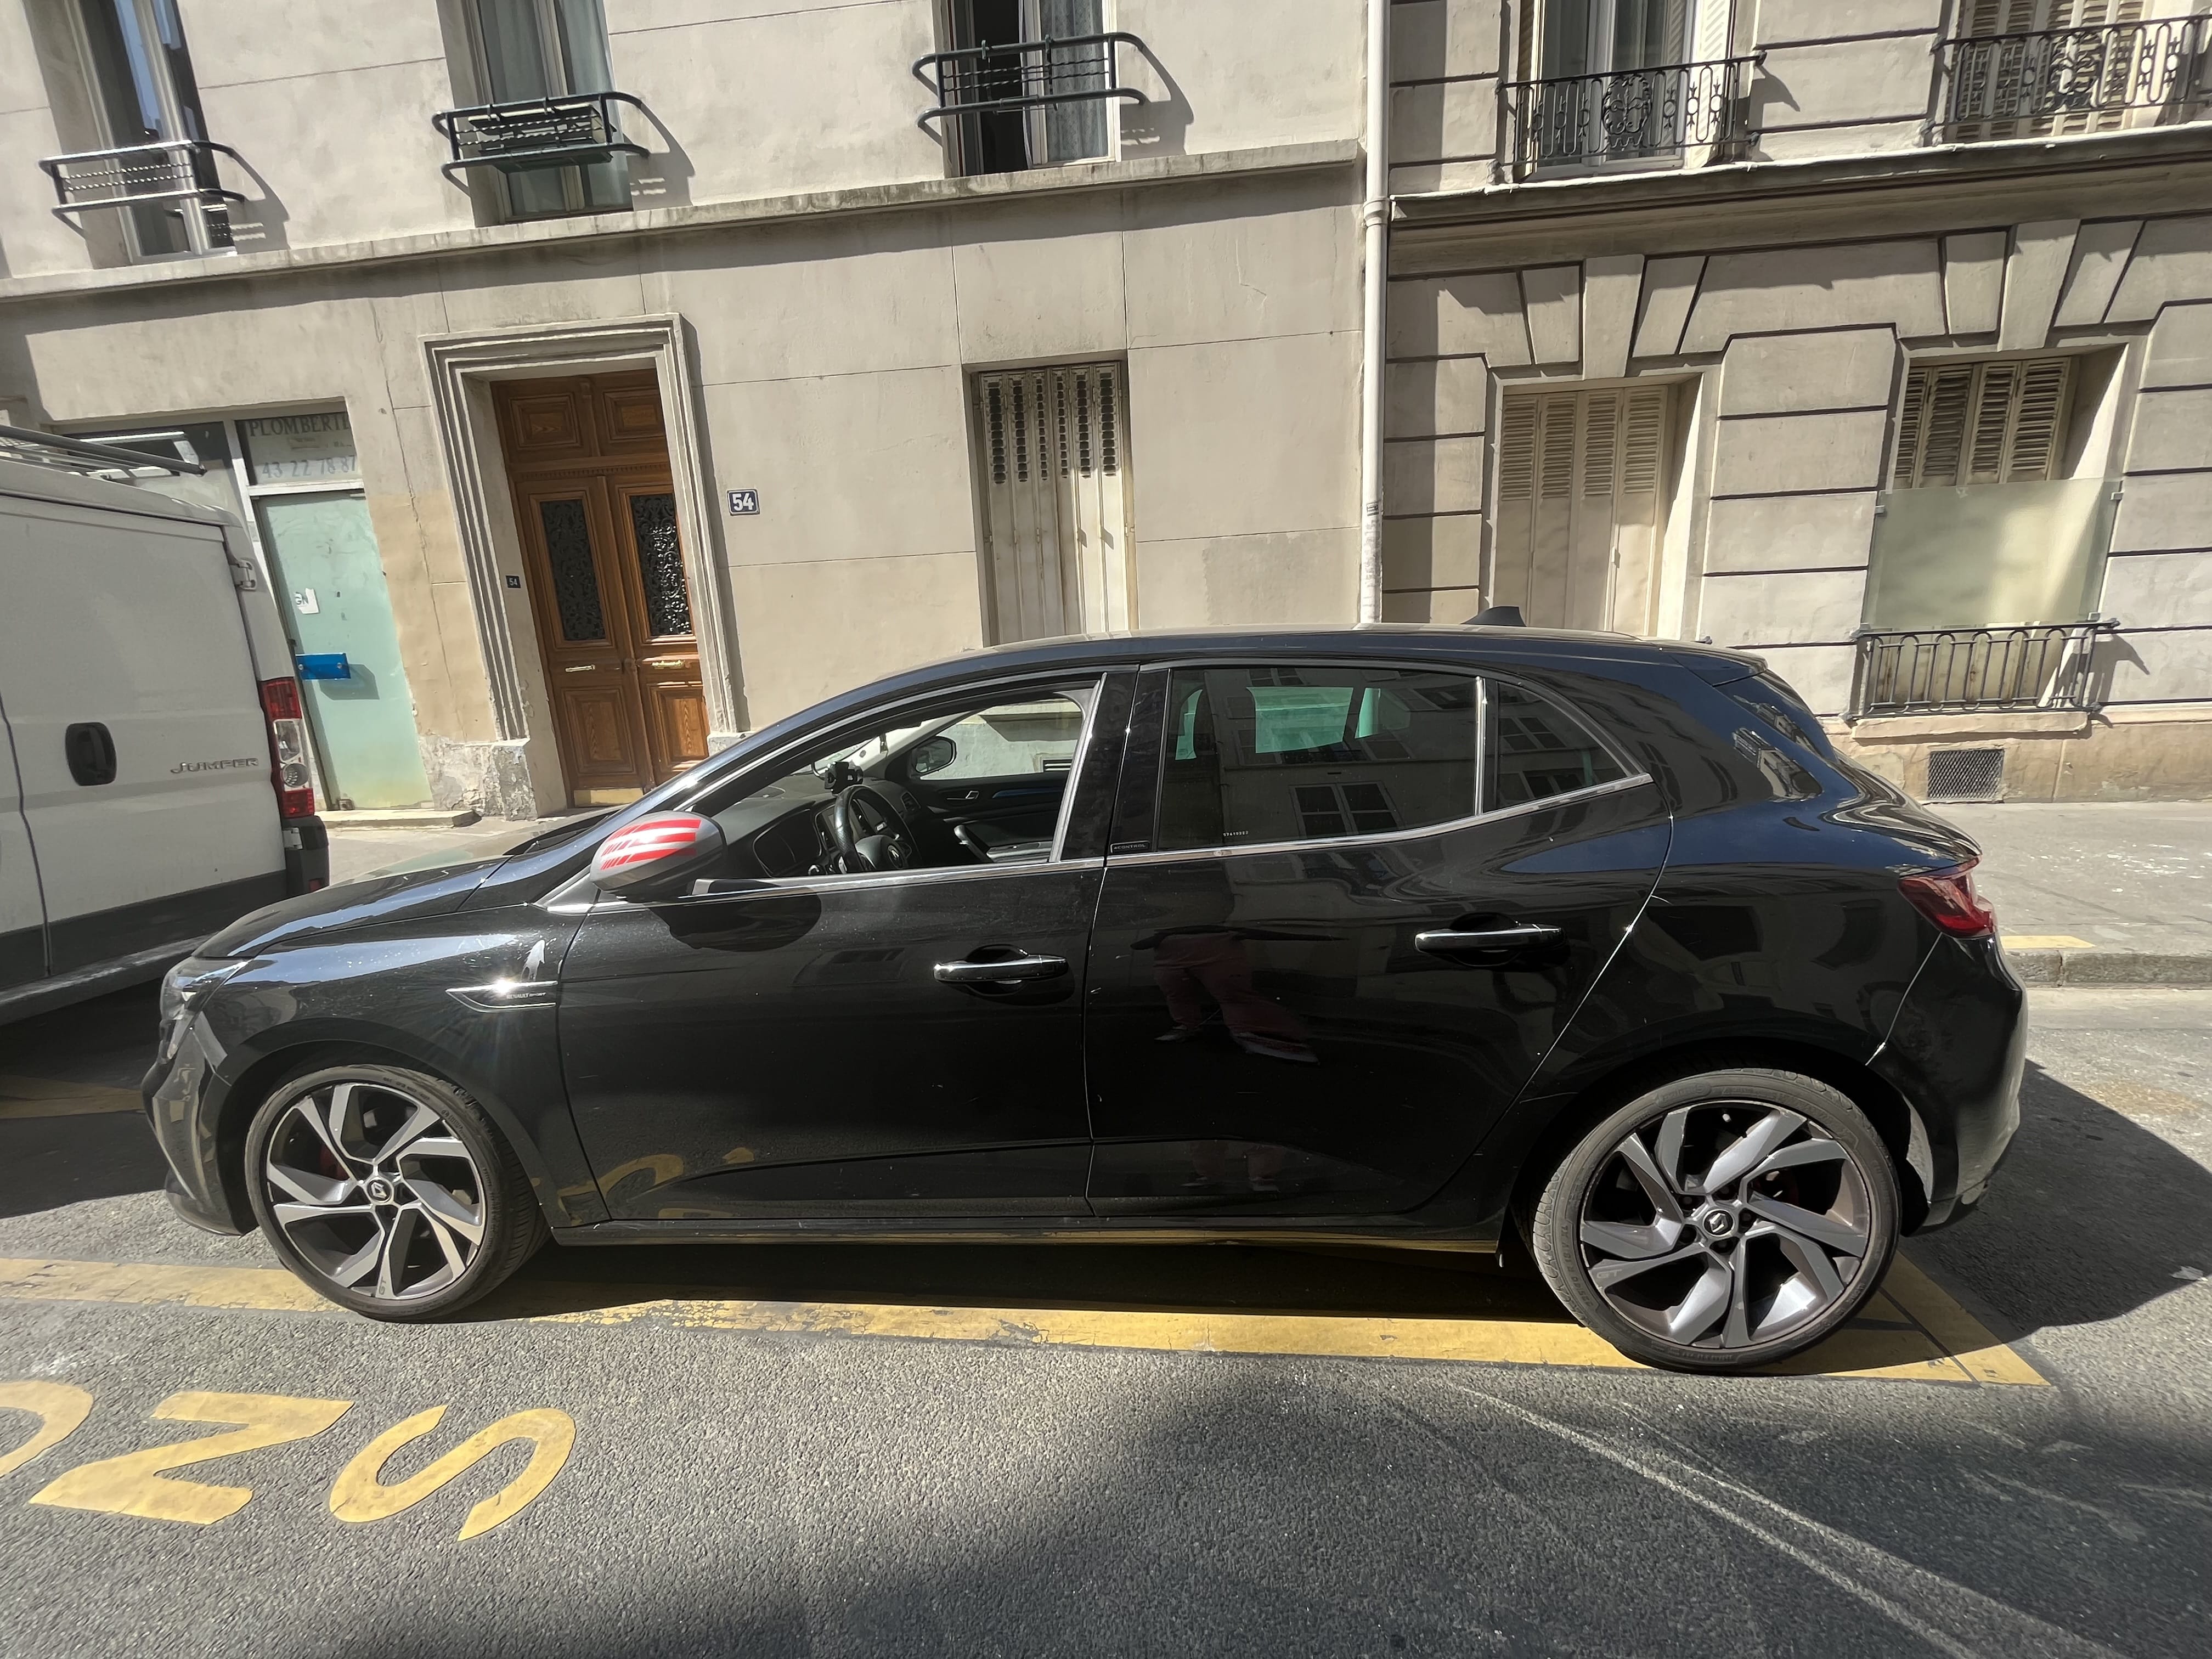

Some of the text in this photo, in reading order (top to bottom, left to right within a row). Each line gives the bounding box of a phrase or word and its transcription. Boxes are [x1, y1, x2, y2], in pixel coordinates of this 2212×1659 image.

[262, 462, 283, 478] 43
[290, 460, 312, 477] 22
[341, 454, 356, 472] 87
[732, 493, 754, 511] 54
[509, 578, 518, 586] 54
[170, 758, 259, 774] JUMPER
[1596, 1268, 1622, 1279] GT
[379, 1276, 387, 1295] GT
